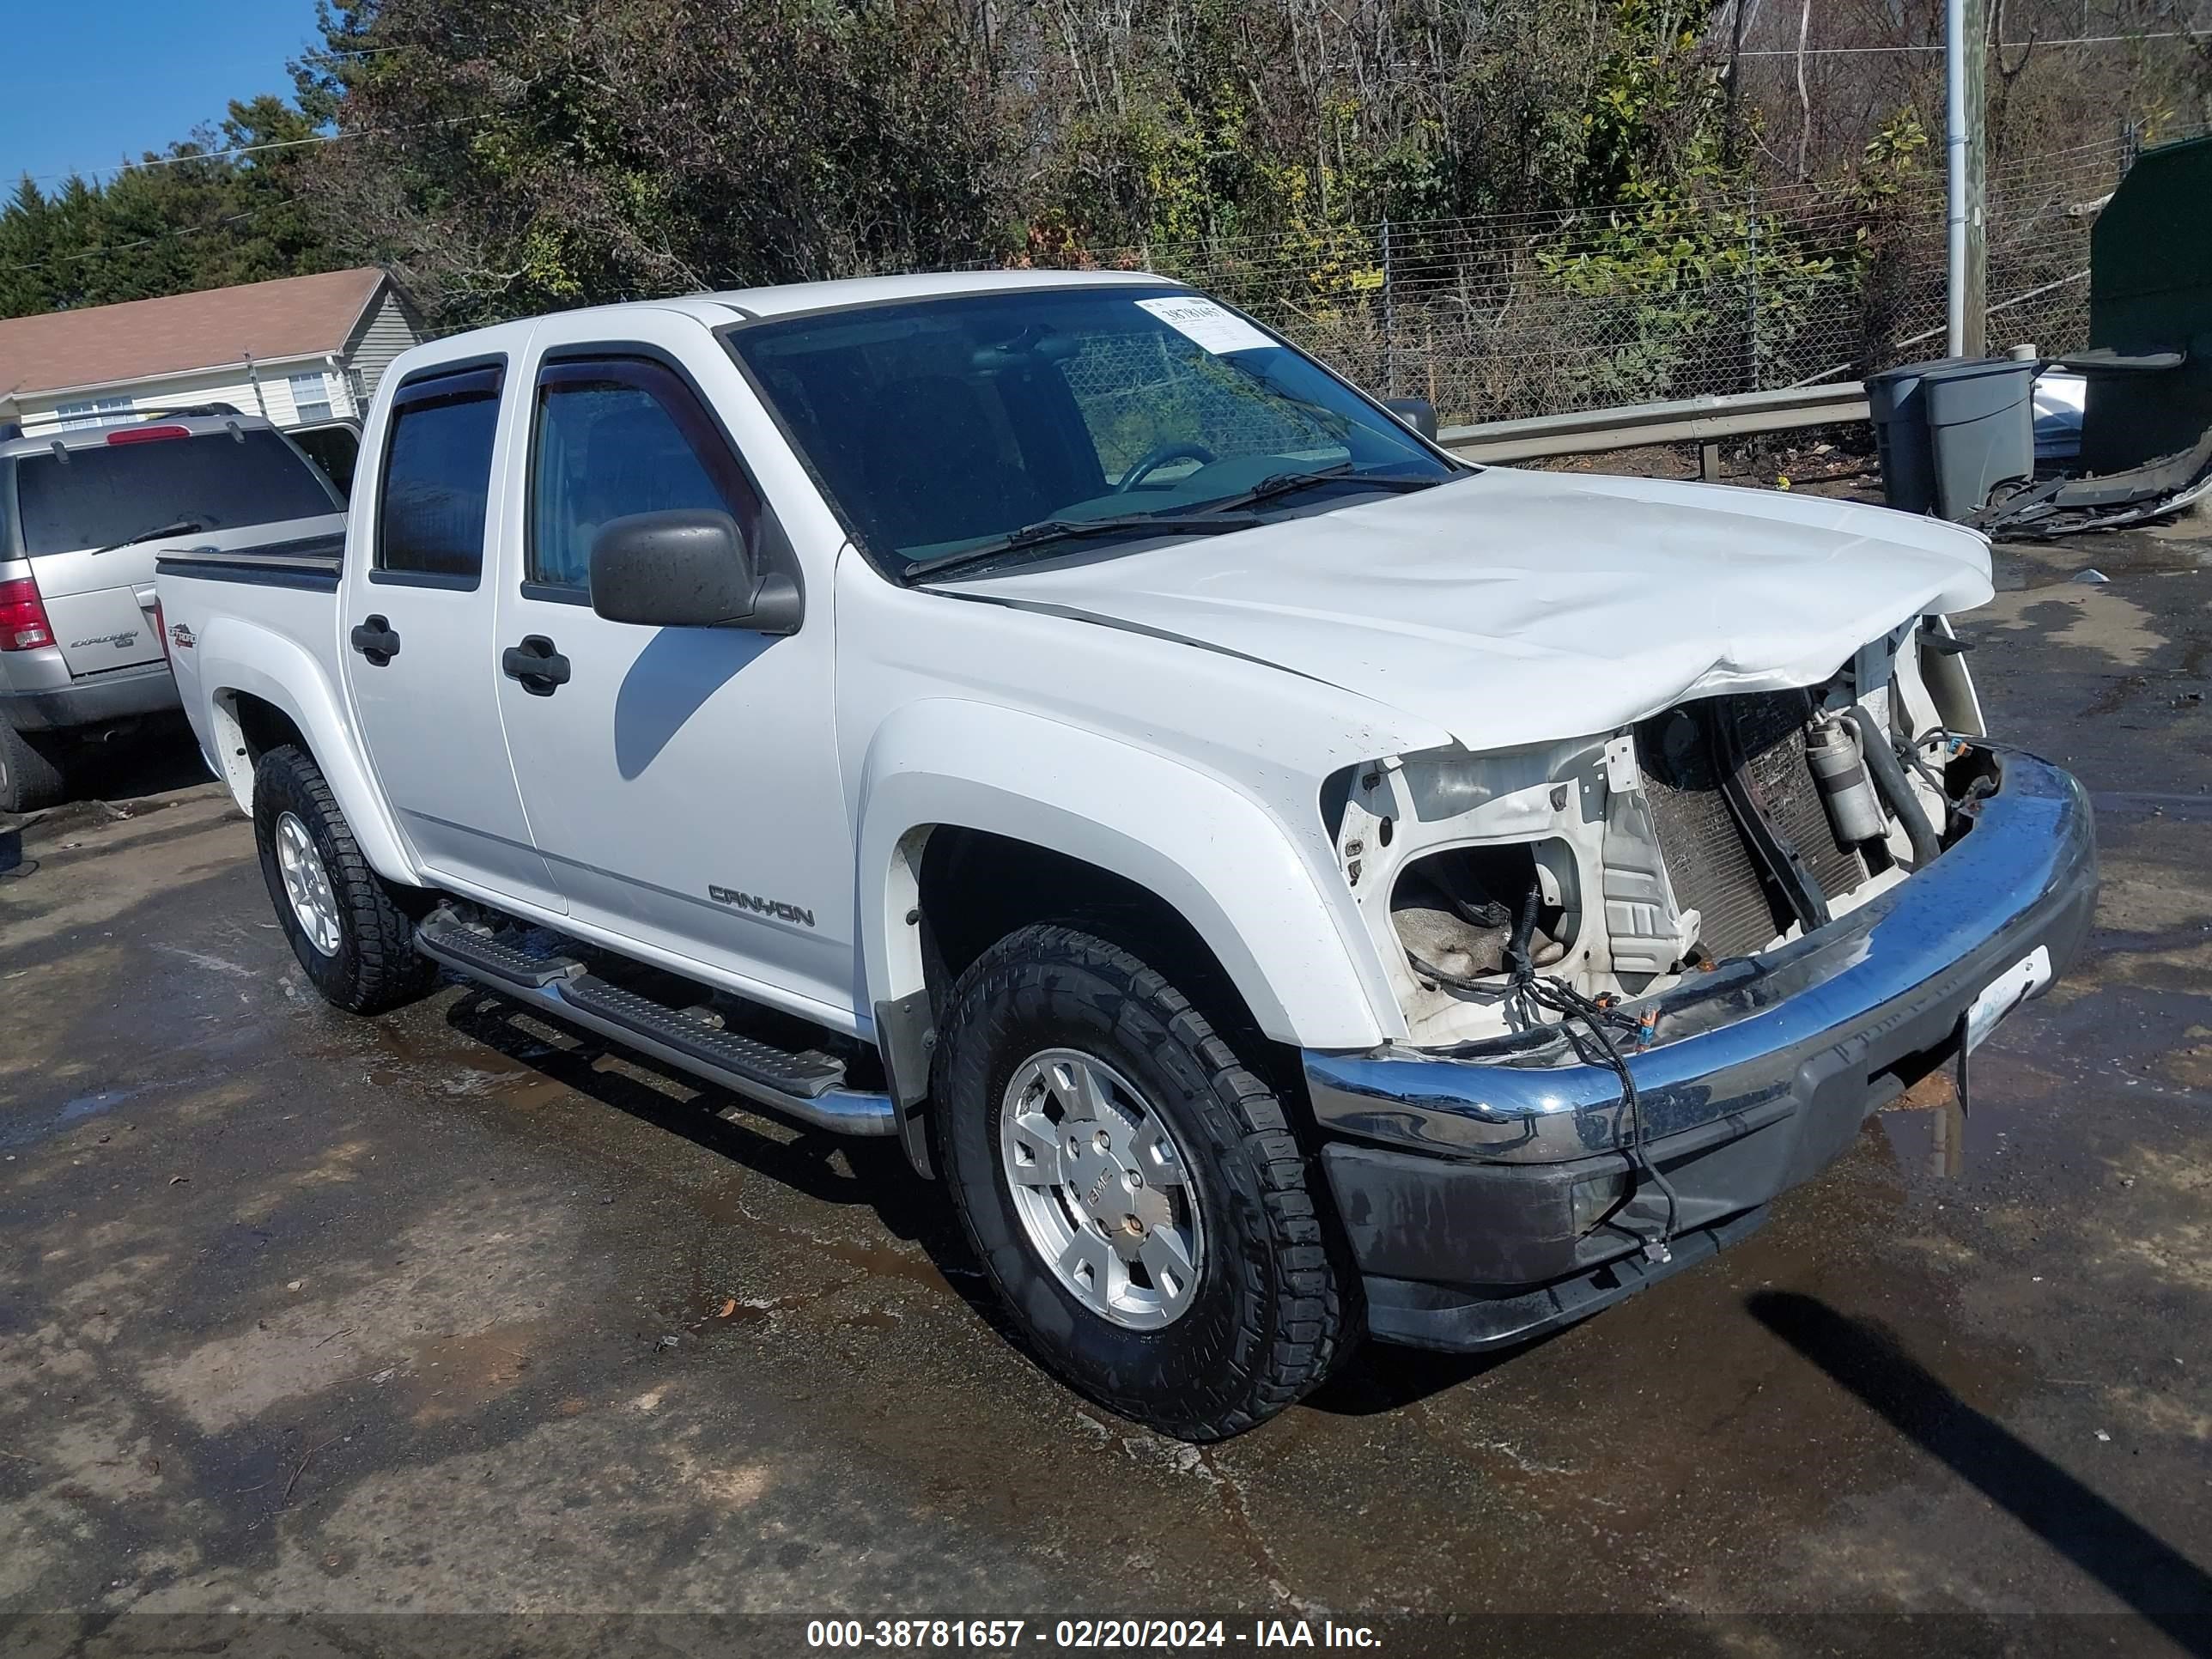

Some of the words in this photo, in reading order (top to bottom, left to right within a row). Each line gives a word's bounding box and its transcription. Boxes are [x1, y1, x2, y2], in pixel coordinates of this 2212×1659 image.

[1162, 307, 1225, 322] 38781657
[70, 631, 139, 648] EXPLORER
[708, 884, 816, 927] CANYON
[1086, 1166, 1114, 1208] GMC
